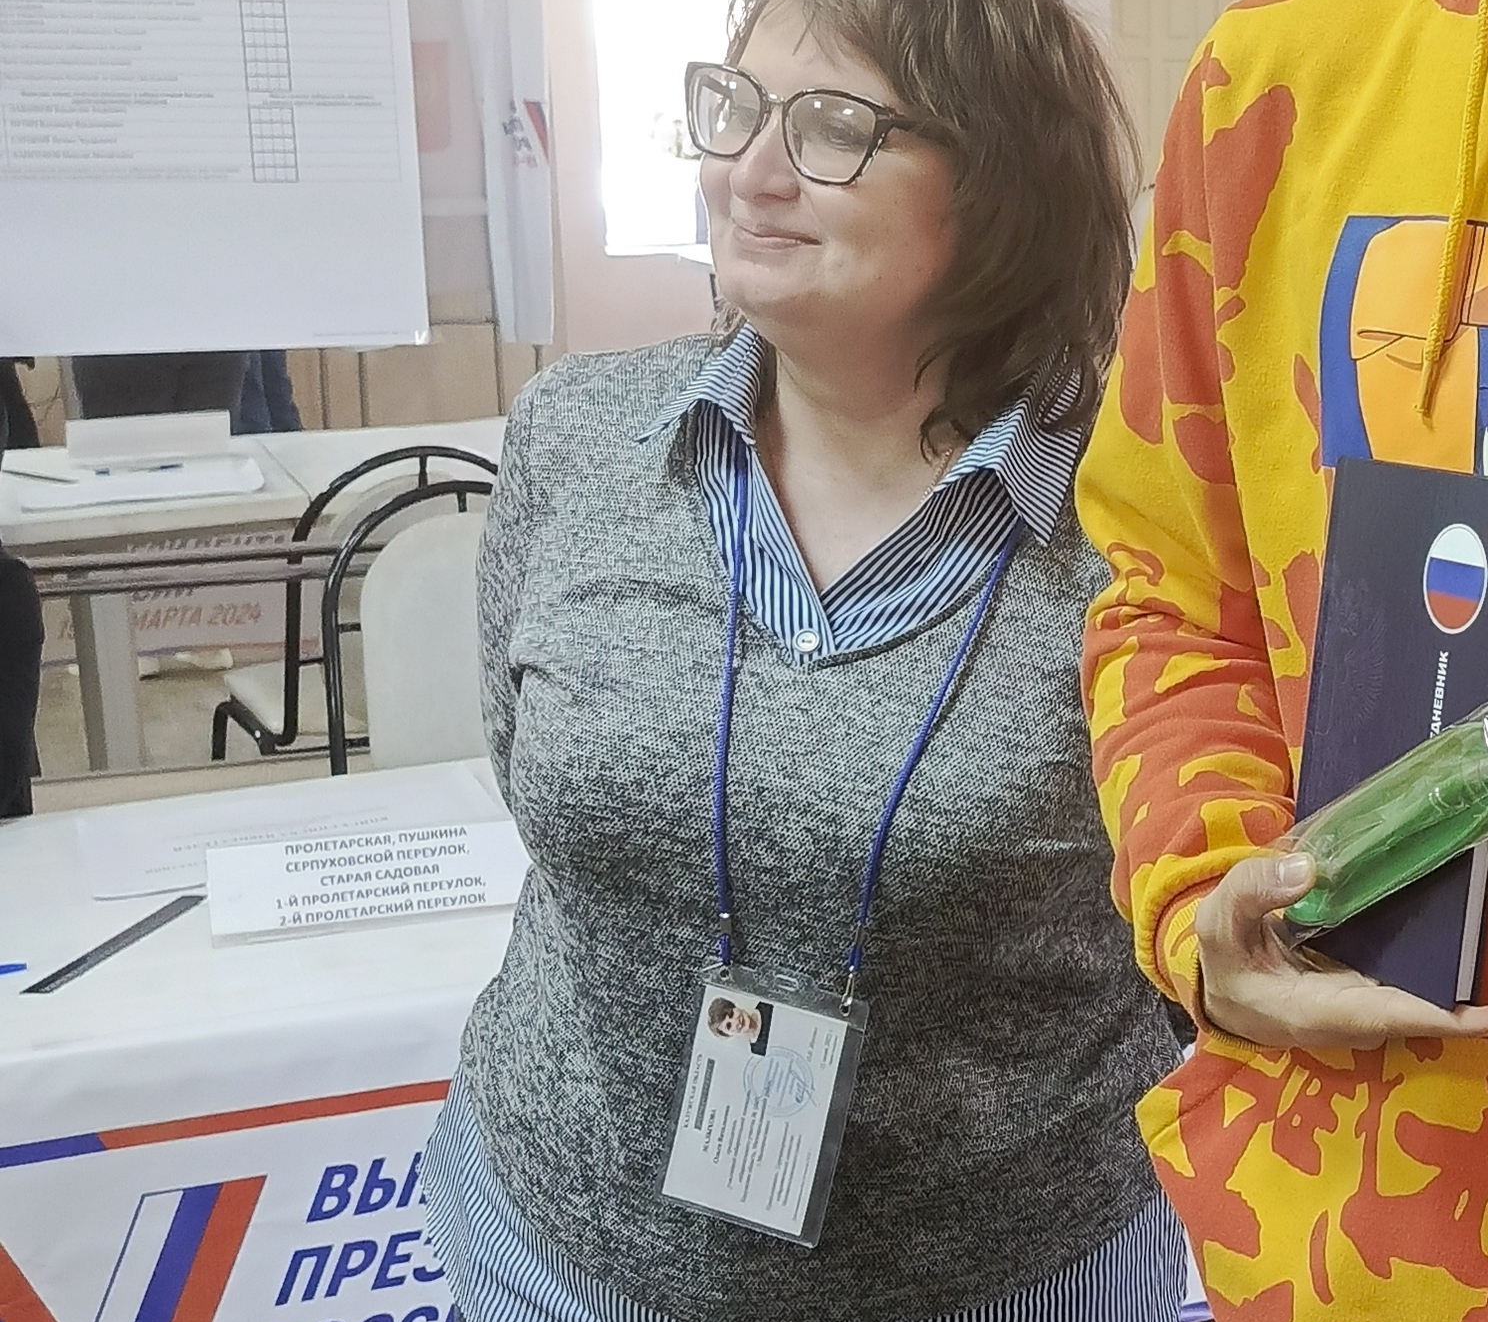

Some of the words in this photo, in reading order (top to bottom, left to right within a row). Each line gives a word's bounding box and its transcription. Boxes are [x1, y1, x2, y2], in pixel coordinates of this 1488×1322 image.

[1429, 650, 1449, 739] ДНЕВНИК
[285, 834, 396, 856] ПРОЛЕТАРСКАЯ,
[398, 826, 468, 843] ПУШКИНА
[285, 849, 395, 873] СЕРПУХОВСКОЙ
[397, 843, 470, 861] ПЕРЕУЛОК,
[320, 871, 373, 887] СТАРАЯ
[375, 864, 440, 881] САДОВАЯ
[276, 894, 299, 910] 1-Й
[302, 881, 410, 906] ПРОЛЕТАРСКИЙ
[413, 876, 486, 893] ПЕРЕУЛОК,
[279, 912, 303, 927] 2-Й
[305, 899, 414, 923] ПРОЛЕТАРСКИЙ
[417, 892, 486, 910] ПЕРЕУЛОК
[306, 1152, 426, 1223] ВЫ
